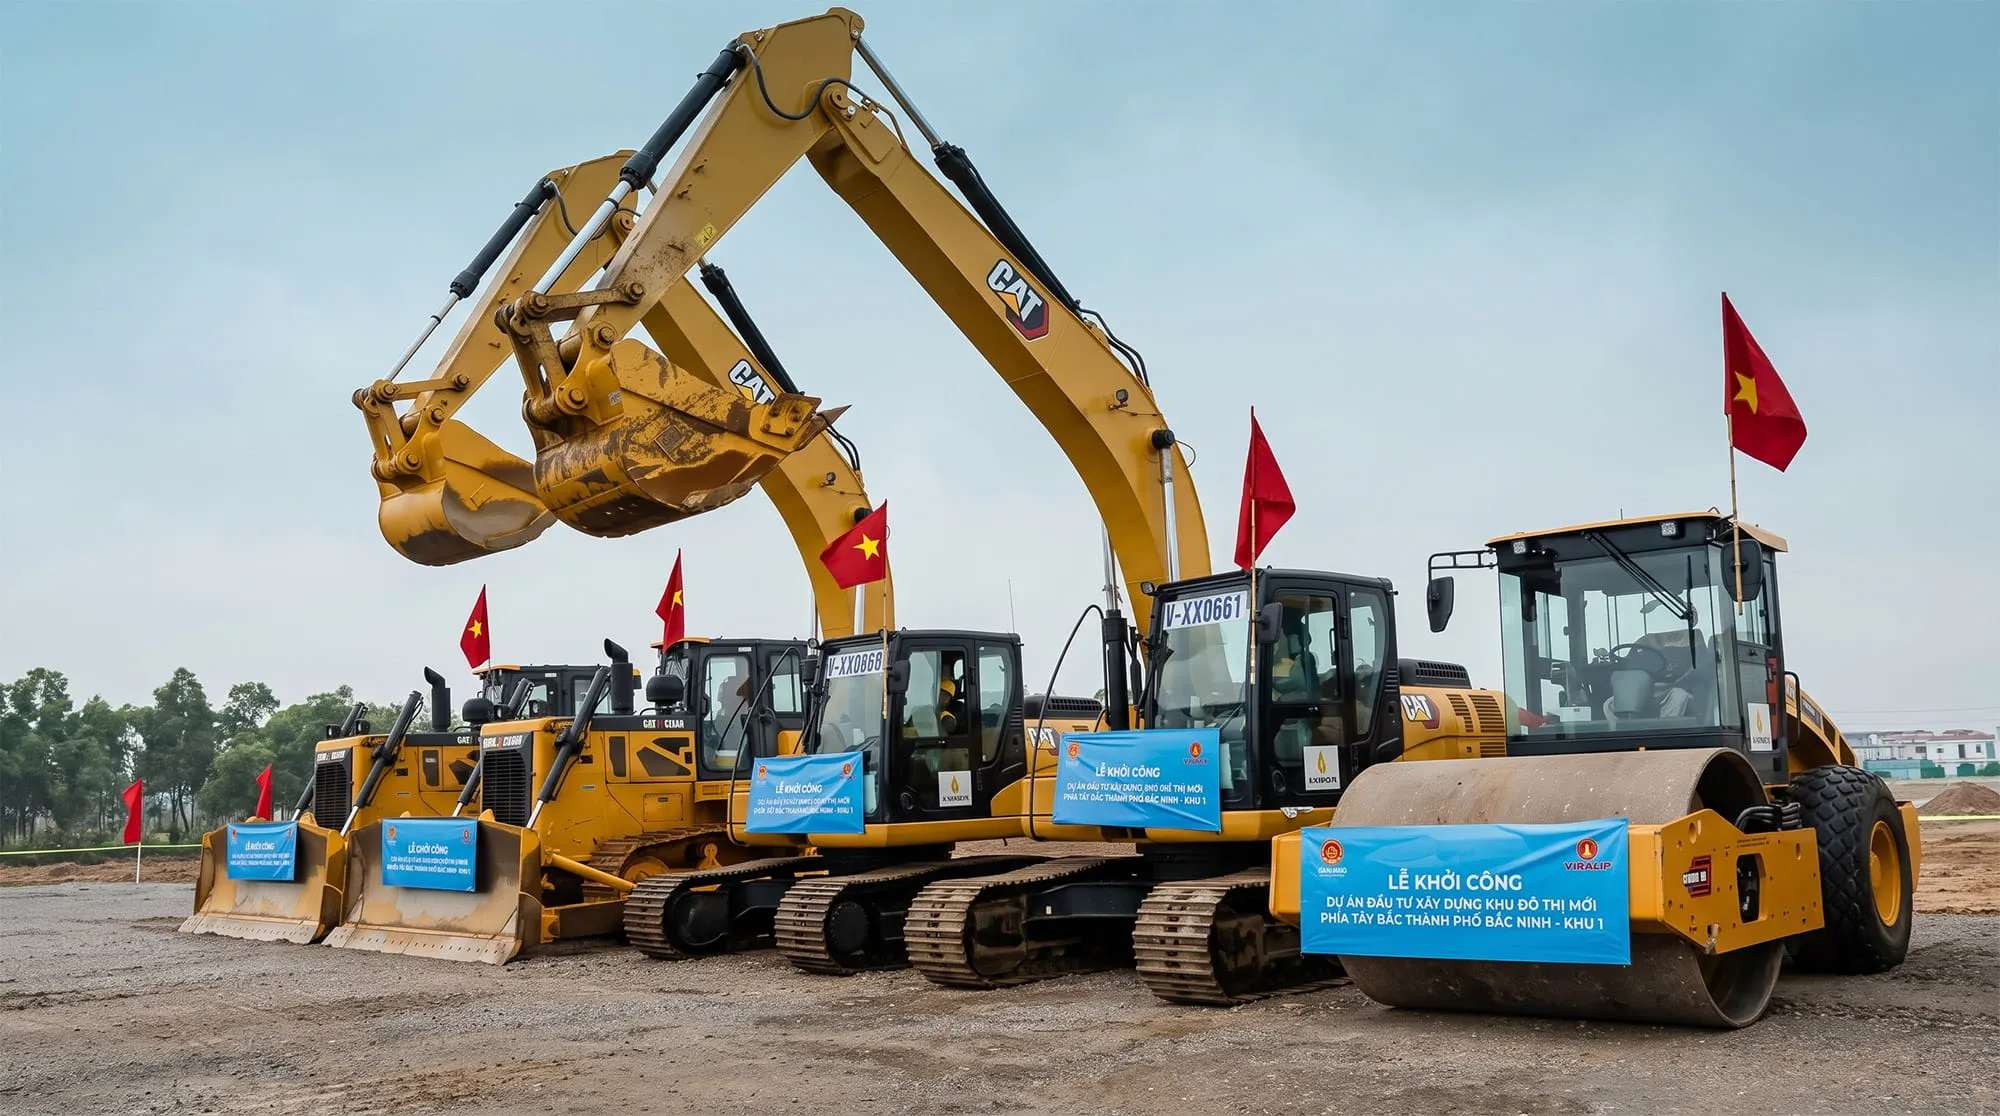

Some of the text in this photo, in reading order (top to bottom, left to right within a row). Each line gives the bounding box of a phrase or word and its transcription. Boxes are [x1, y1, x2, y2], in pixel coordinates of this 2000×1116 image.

[988, 260, 1043, 322] CAT
[729, 360, 775, 404] CAT
[1166, 594, 1241, 627] V-XX0661
[1400, 695, 1432, 721] CAT
[1027, 727, 1057, 749] CAT
[1132, 765, 1160, 778] CÔNG
[1564, 862, 1612, 871] VIRALIP
[1388, 868, 1522, 891] LỄ KHỞI CÔNG
[1326, 895, 1344, 912] DỰ
[1346, 894, 1363, 908] ÁN
[1396, 896, 1413, 909] TƯ
[1444, 897, 1482, 912] DỰNG
[1486, 899, 1513, 910] KHU
[1518, 896, 1539, 911] ĐÔ
[1542, 899, 1565, 914] THỊ
[1569, 896, 1597, 911] MỚI
[1320, 910, 1350, 924] PHÍA
[1352, 910, 1374, 925] TÂY
[1377, 909, 1402, 925] BẮC
[1405, 912, 1450, 926] THÀNH
[1453, 911, 1482, 927] PHỐ
[1485, 911, 1513, 928] BẮC
[1517, 916, 1551, 929] NINH
[1564, 917, 1594, 929] KHU
[1598, 918, 1604, 930] 1
